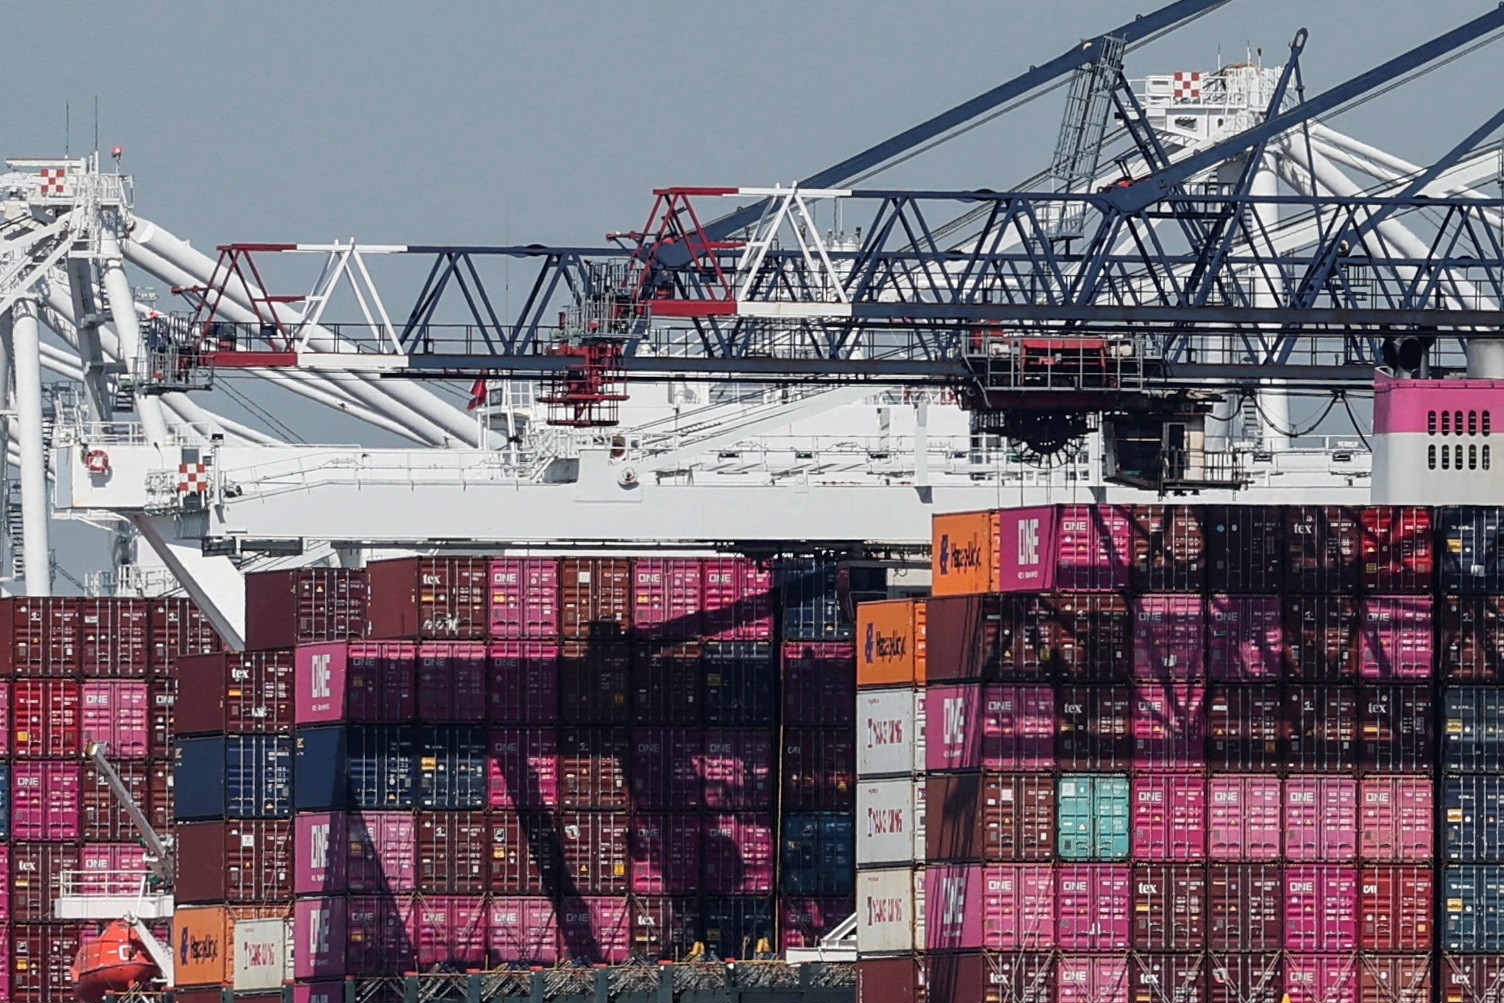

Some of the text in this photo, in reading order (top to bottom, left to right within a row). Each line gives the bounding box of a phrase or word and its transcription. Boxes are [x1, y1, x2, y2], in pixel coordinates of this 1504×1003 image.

[1063, 522, 1086, 531] ONE
[1294, 523, 1312, 534] tex
[1018, 518, 1040, 564] ONE
[423, 572, 441, 586] tex
[494, 573, 516, 583] ONE
[638, 573, 660, 583] ONE
[709, 573, 731, 583] ONE
[1138, 612, 1161, 622] ONE
[1215, 612, 1238, 622] ONE
[1367, 613, 1390, 622] ONE
[232, 668, 250, 680] tex
[312, 654, 330, 698] ONE
[86, 696, 108, 704] ONE
[989, 701, 1011, 711] ONE
[1064, 702, 1082, 714] tex
[1138, 702, 1161, 711] ONE
[1368, 702, 1386, 714] tex
[943, 698, 964, 744] ONE
[17, 777, 38, 786] ONE
[1138, 792, 1162, 802] ONE
[1214, 792, 1238, 802] ONE
[1290, 792, 1313, 802] ONE
[1366, 792, 1389, 802] ONE
[311, 824, 329, 868] ONE
[18, 860, 36, 872] tex
[85, 860, 108, 869] ONE
[988, 880, 1012, 891] ONE
[1063, 881, 1086, 891] ONE
[1138, 882, 1156, 895] tex
[1290, 882, 1313, 892] ONE
[943, 878, 964, 924] ONE
[638, 914, 655, 926] tex
[310, 910, 330, 954] ONE
[990, 972, 1008, 984] tex
[1140, 972, 1159, 984] tex
[1452, 973, 1470, 986] tex
